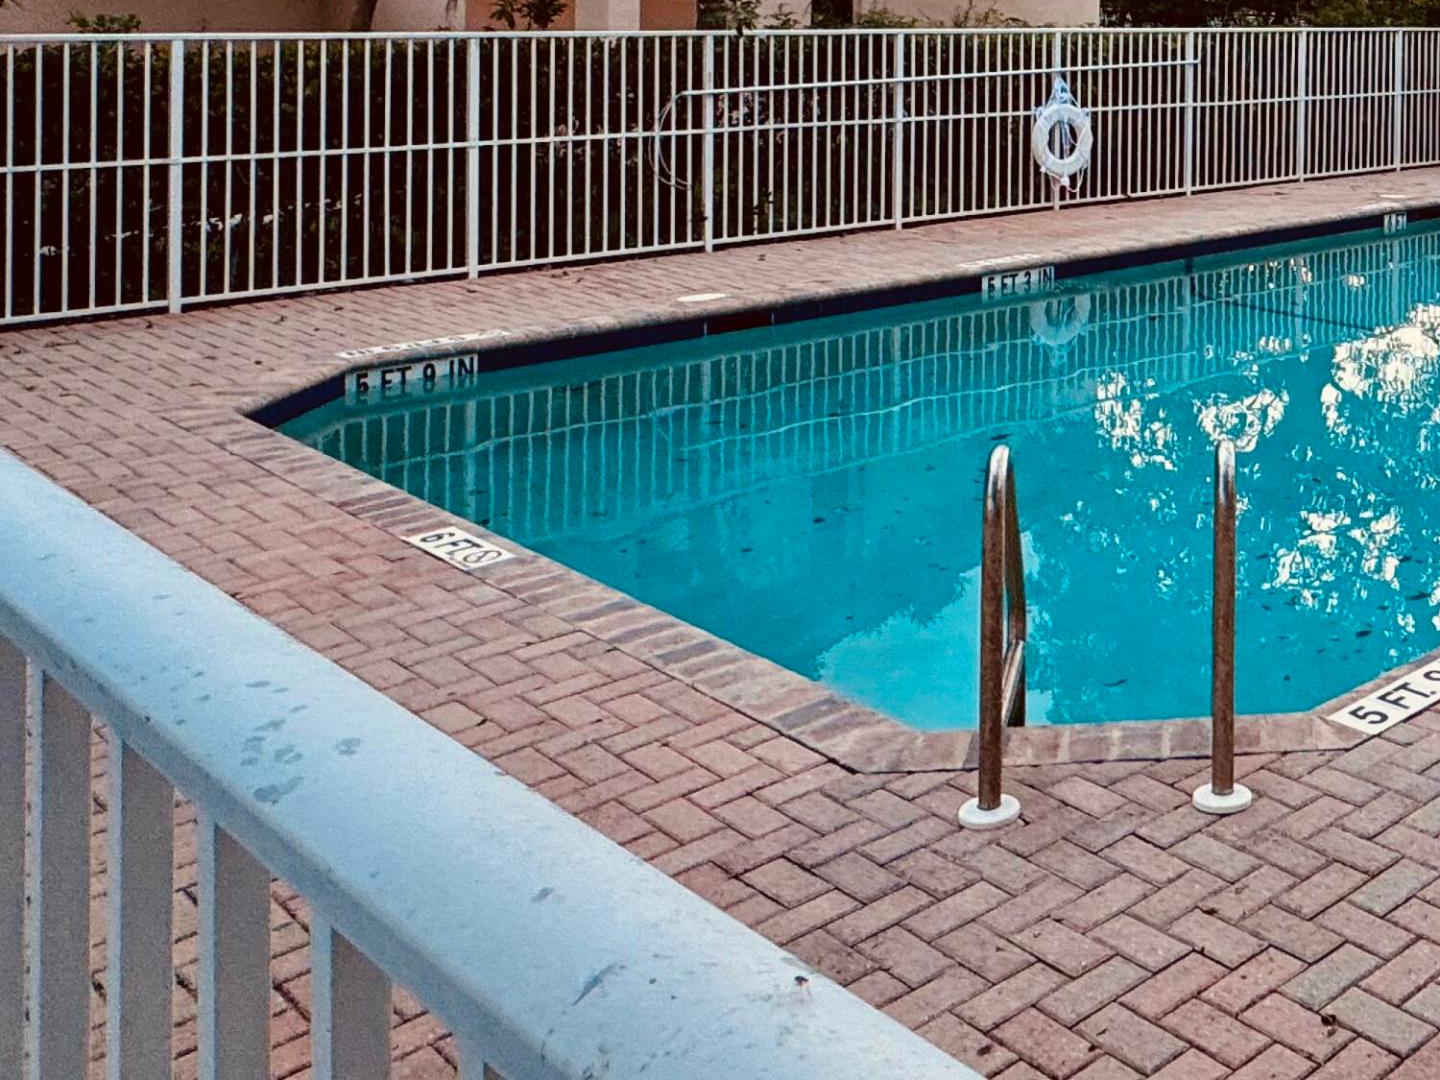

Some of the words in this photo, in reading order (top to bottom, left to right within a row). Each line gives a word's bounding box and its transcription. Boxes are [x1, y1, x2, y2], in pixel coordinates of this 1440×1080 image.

[449, 356, 475, 380] IN
[419, 532, 456, 542] 6
[1348, 705, 1389, 725] 5
[1376, 681, 1437, 710] FT.
